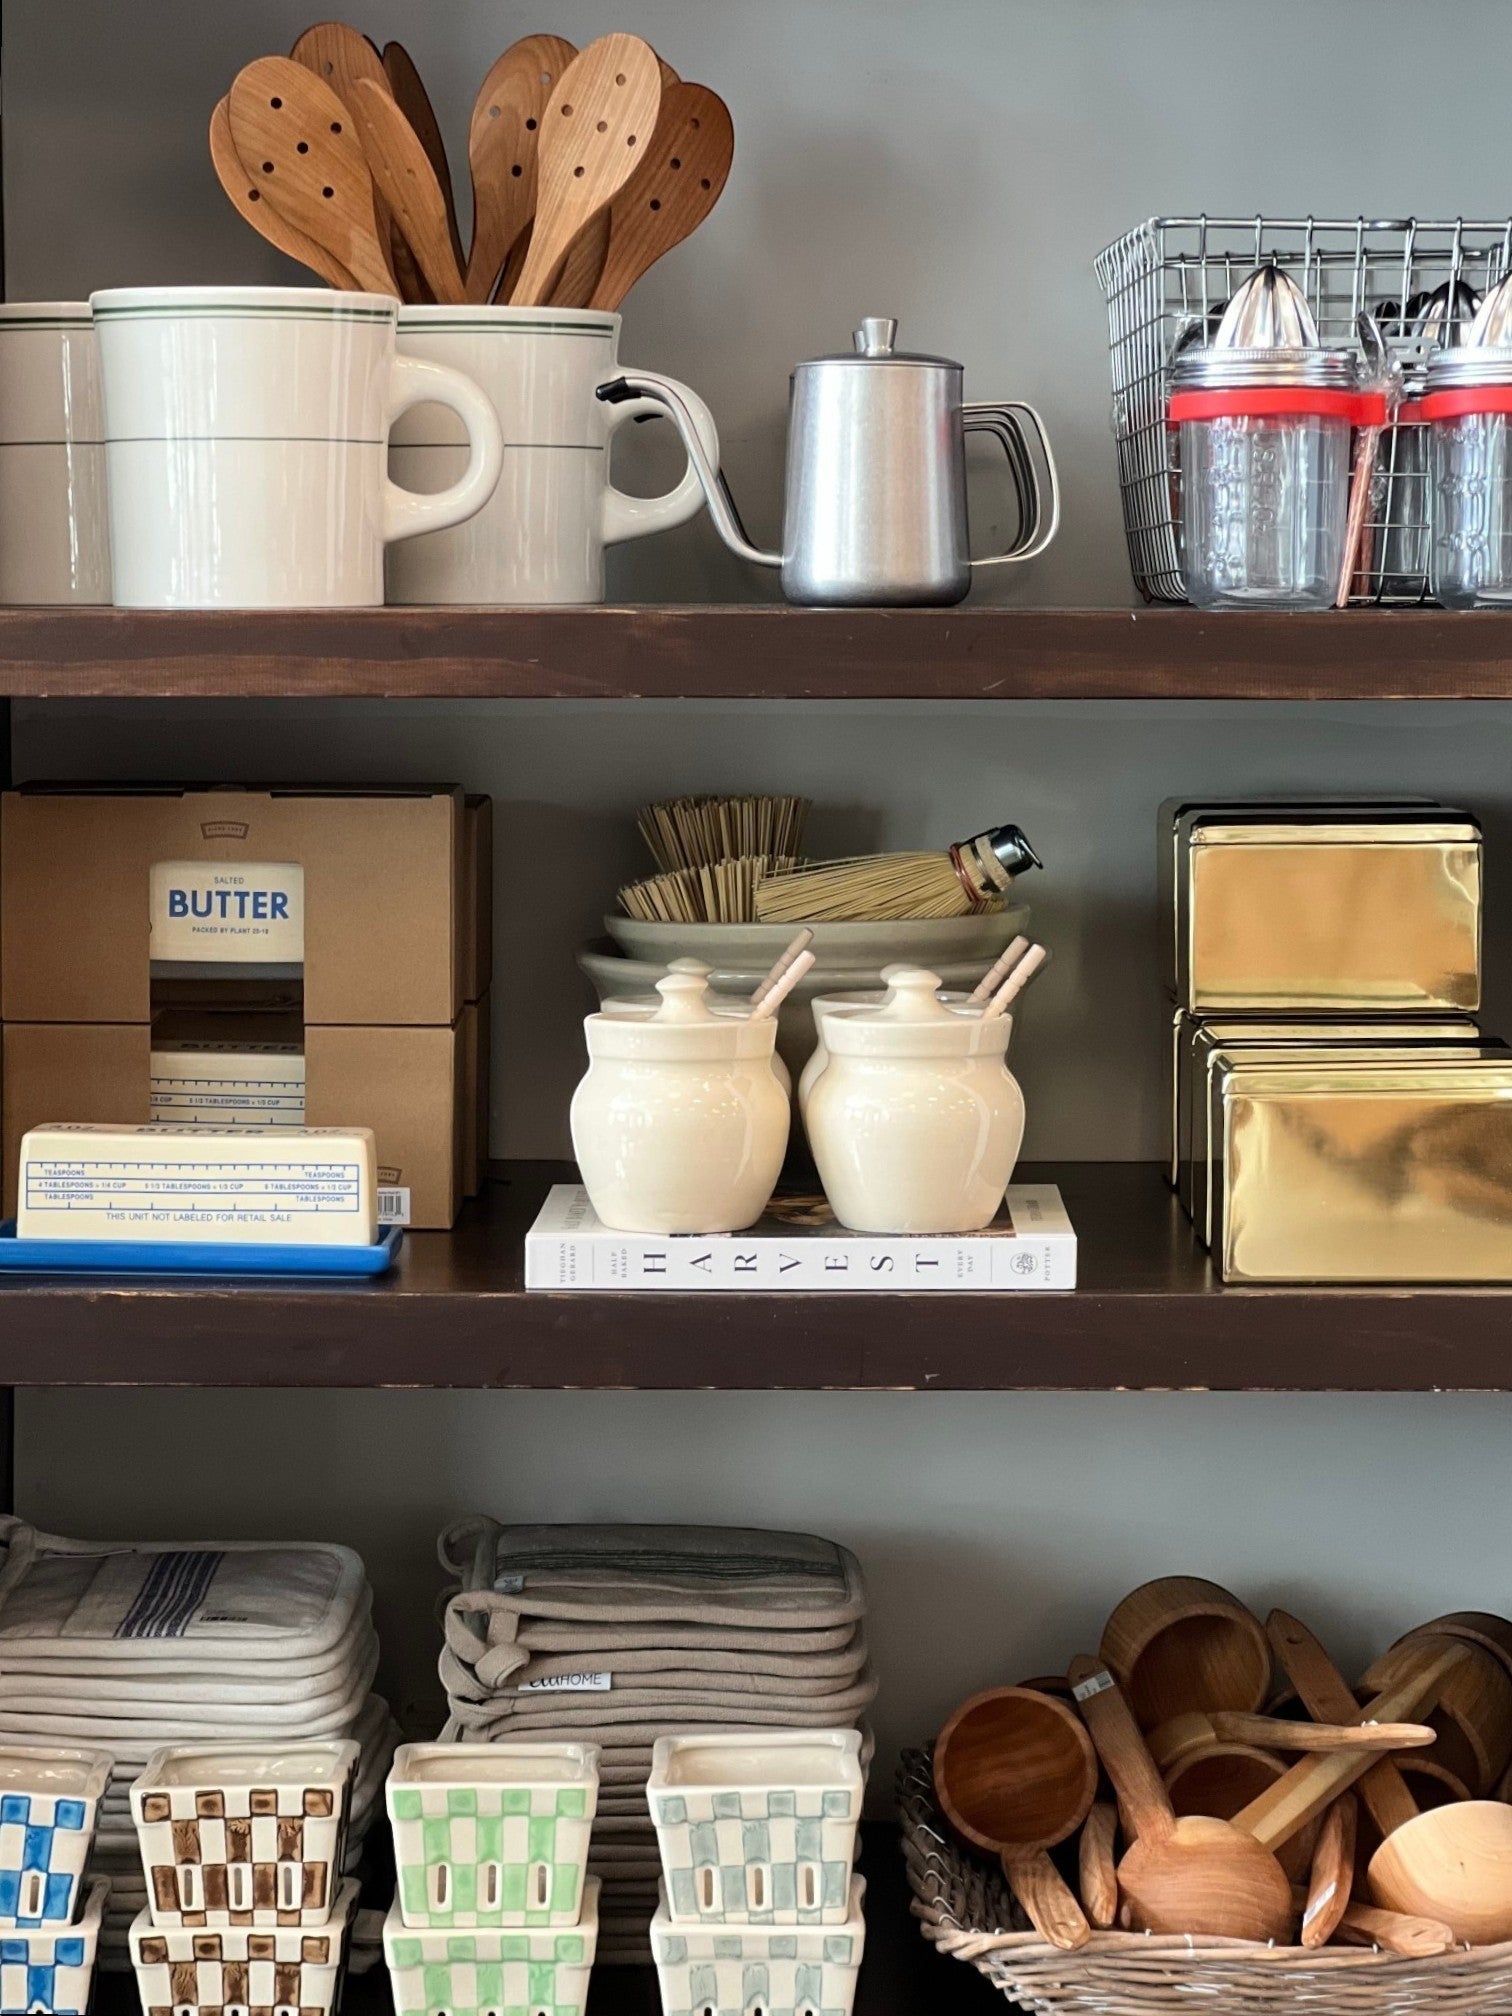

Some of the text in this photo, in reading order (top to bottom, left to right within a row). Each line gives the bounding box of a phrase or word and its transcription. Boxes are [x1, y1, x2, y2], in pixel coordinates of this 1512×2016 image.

[214, 876, 244, 884] SALTED
[169, 890, 289, 919] BUTTER
[644, 1252, 939, 1273] HARVEST
